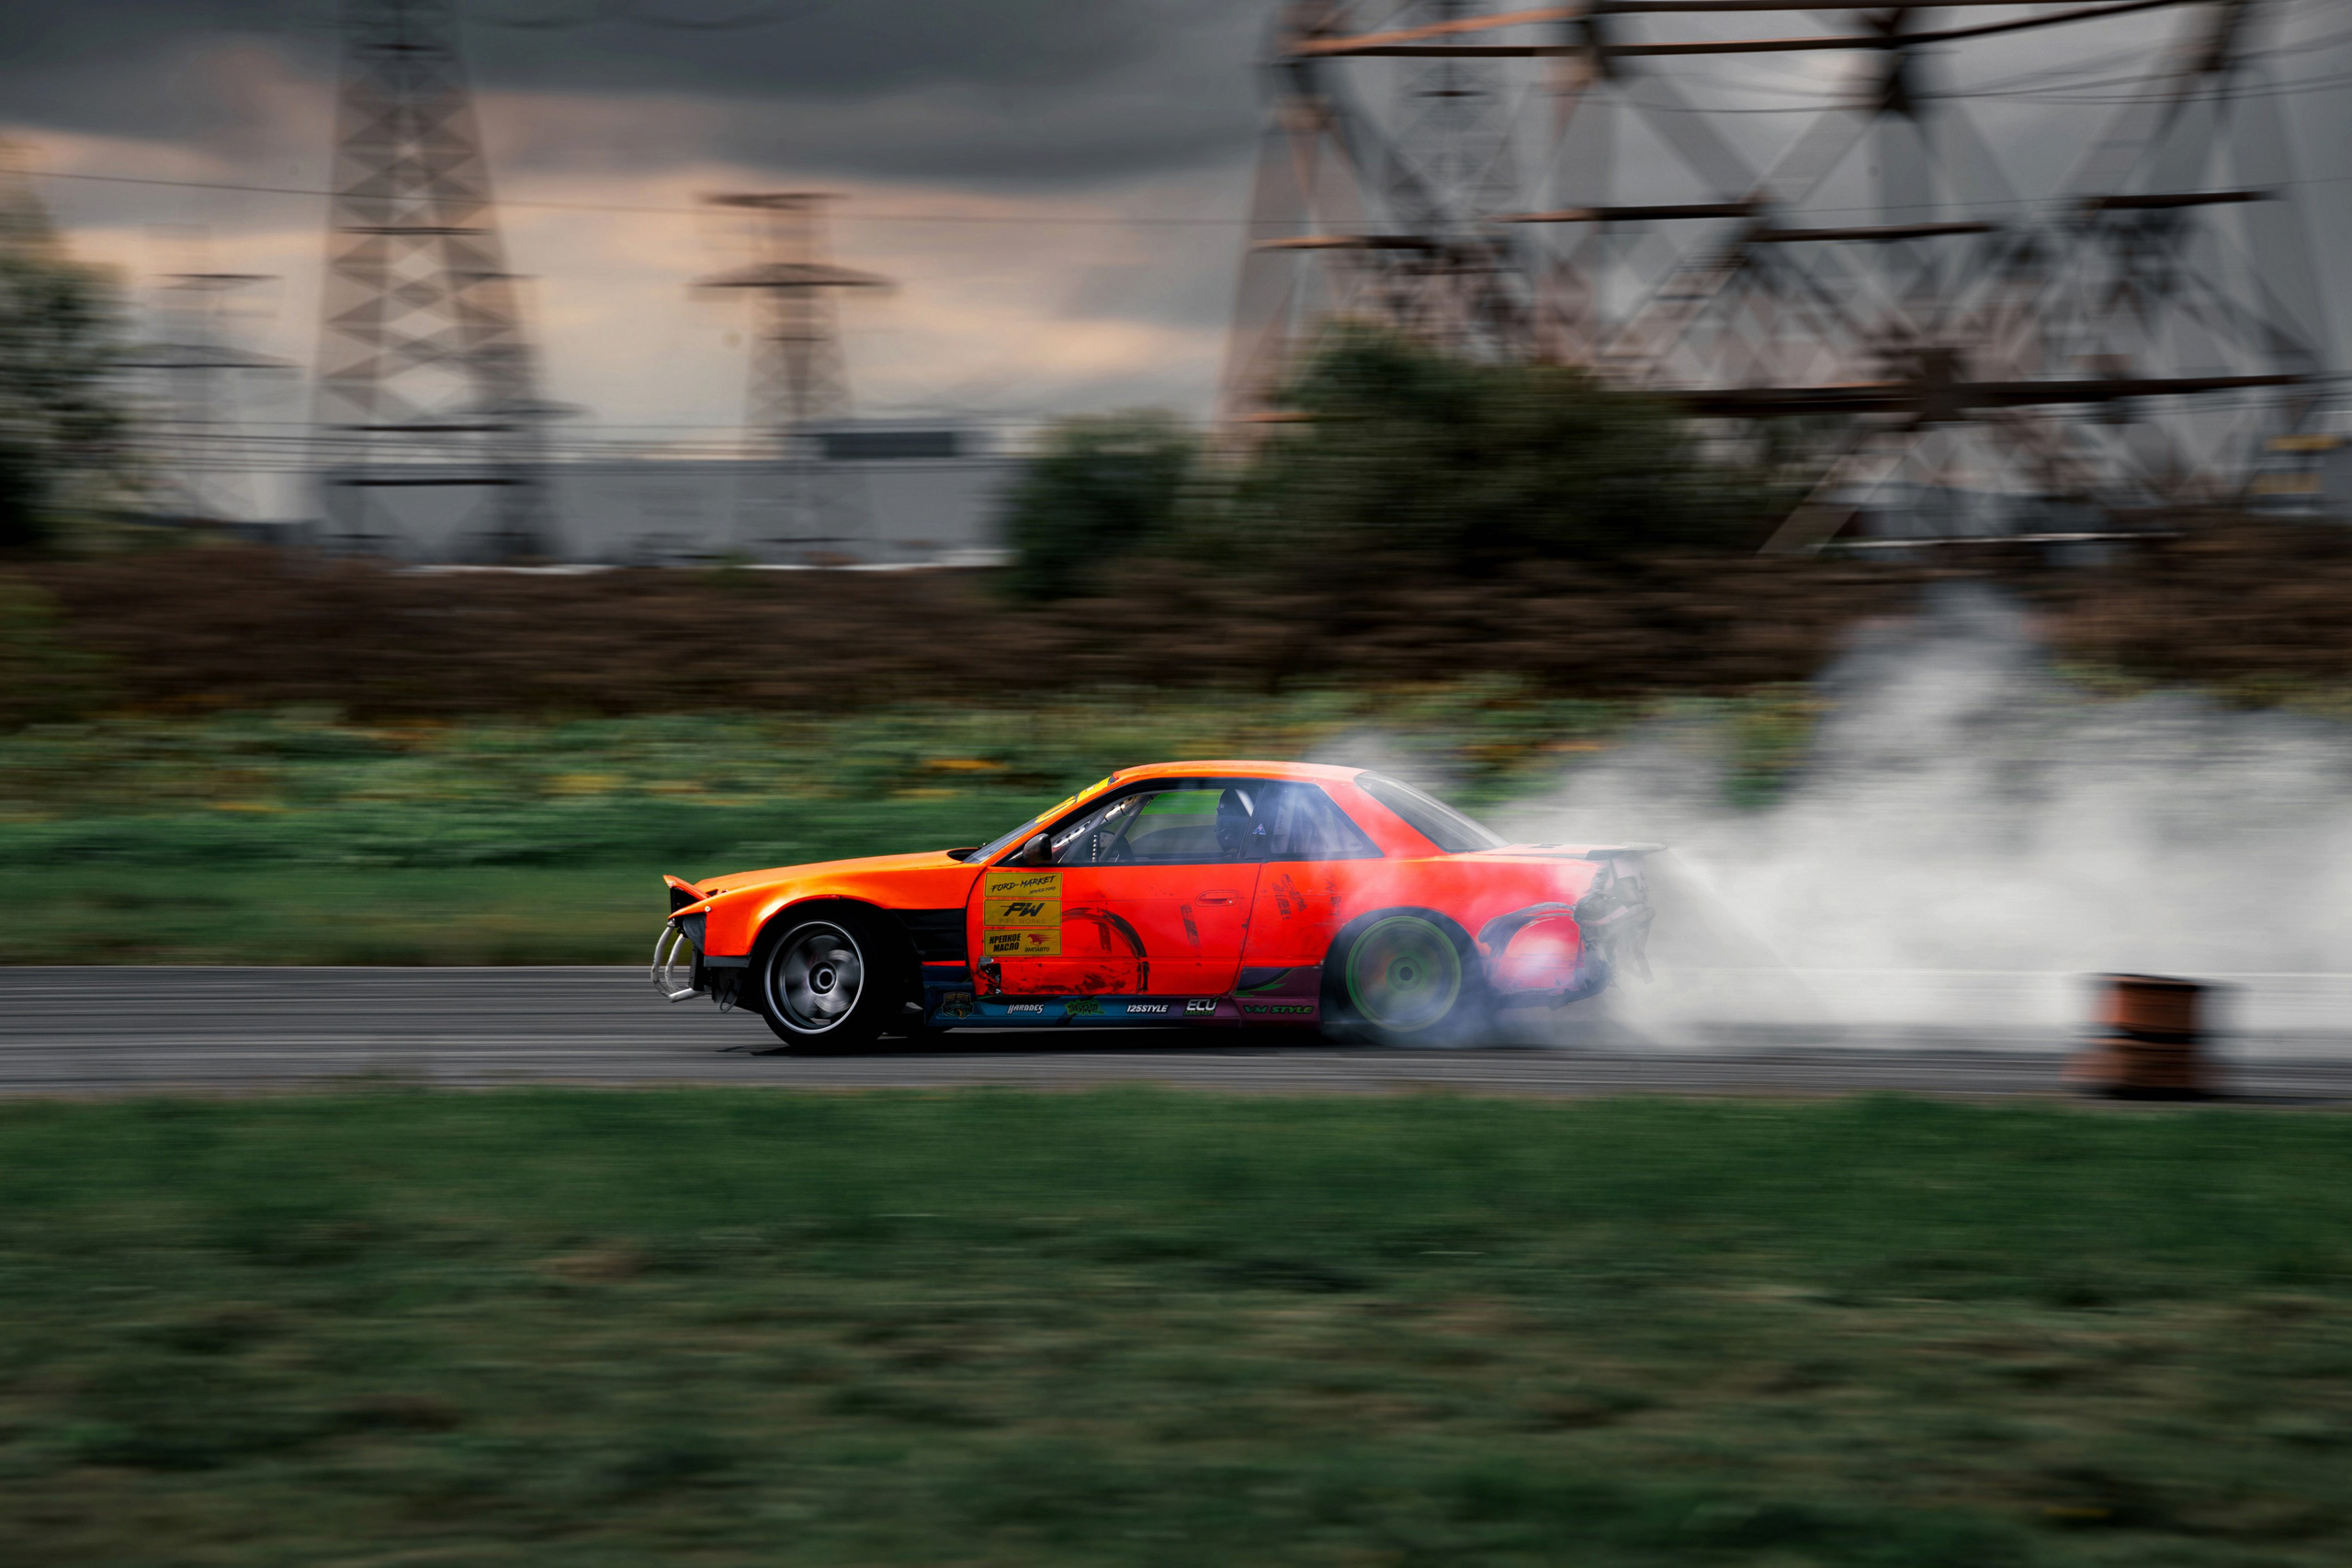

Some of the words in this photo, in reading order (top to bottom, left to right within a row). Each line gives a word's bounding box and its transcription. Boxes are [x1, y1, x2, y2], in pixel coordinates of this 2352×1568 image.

[991, 875, 1057, 893] FORD-MARKET
[1000, 902, 1046, 917] PW
[989, 933, 1021, 944] КРЕПКОЕ
[993, 942, 1020, 953] МАСЛО
[1126, 1004, 1169, 1012] 125STYLE
[1186, 998, 1217, 1010] ECU
[1243, 1006, 1268, 1014] VM
[1271, 1006, 1315, 1014] STYLE
